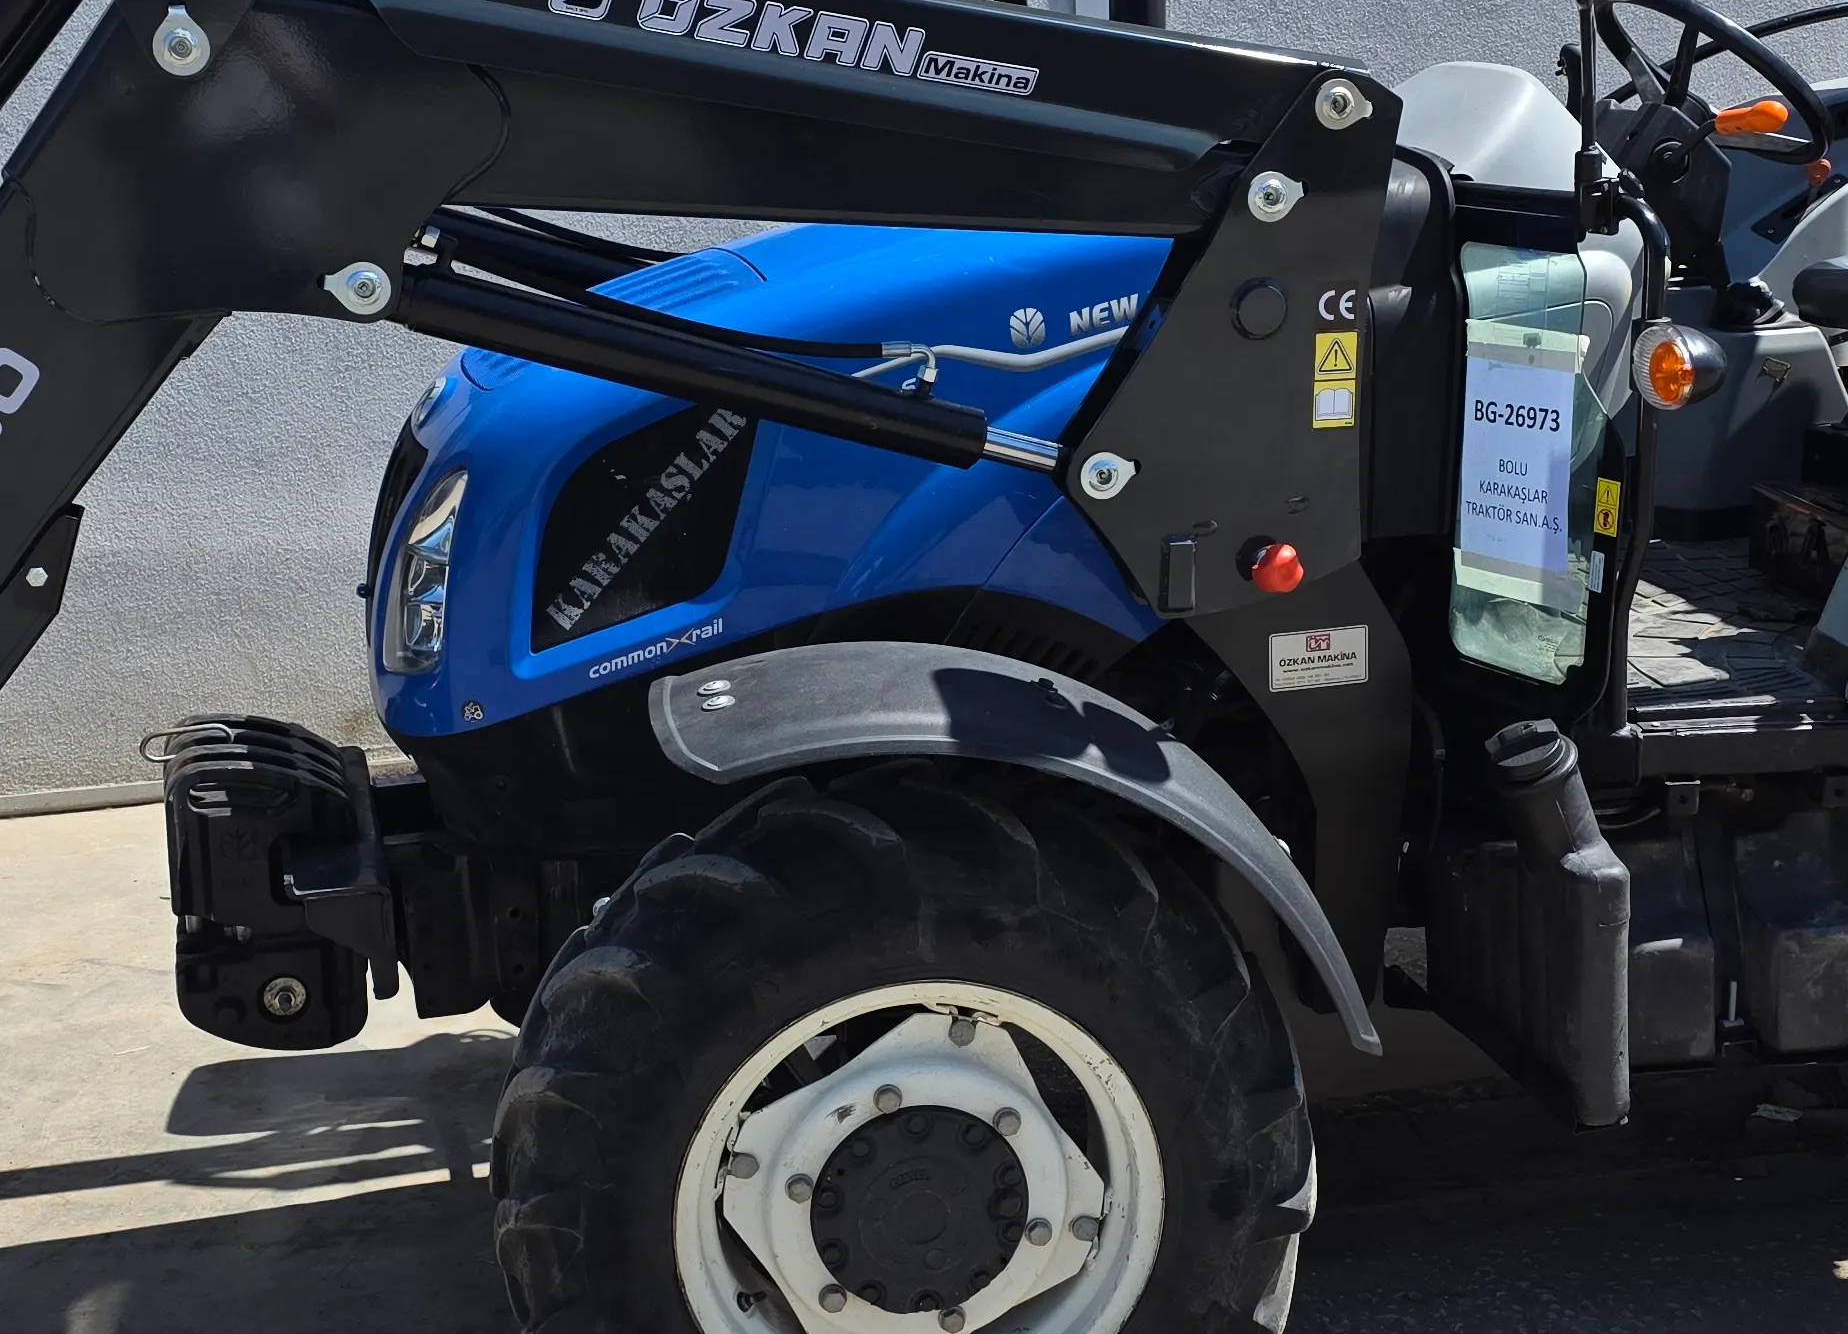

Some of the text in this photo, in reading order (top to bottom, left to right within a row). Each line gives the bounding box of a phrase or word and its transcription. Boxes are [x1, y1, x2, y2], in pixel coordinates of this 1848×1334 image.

[922, 56, 1031, 92] Makina
[1069, 293, 1139, 336] NEW
[1318, 289, 1356, 321] CE
[1474, 399, 1561, 432] BG-26973
[1498, 458, 1528, 476] BOLU
[1479, 479, 1549, 505] KARAKAŞLAR
[1466, 500, 1563, 535] TRAKTÖR SAN.A.Ş.
[588, 617, 724, 680] common rail
[1317, 651, 1358, 664] MAKİNA
